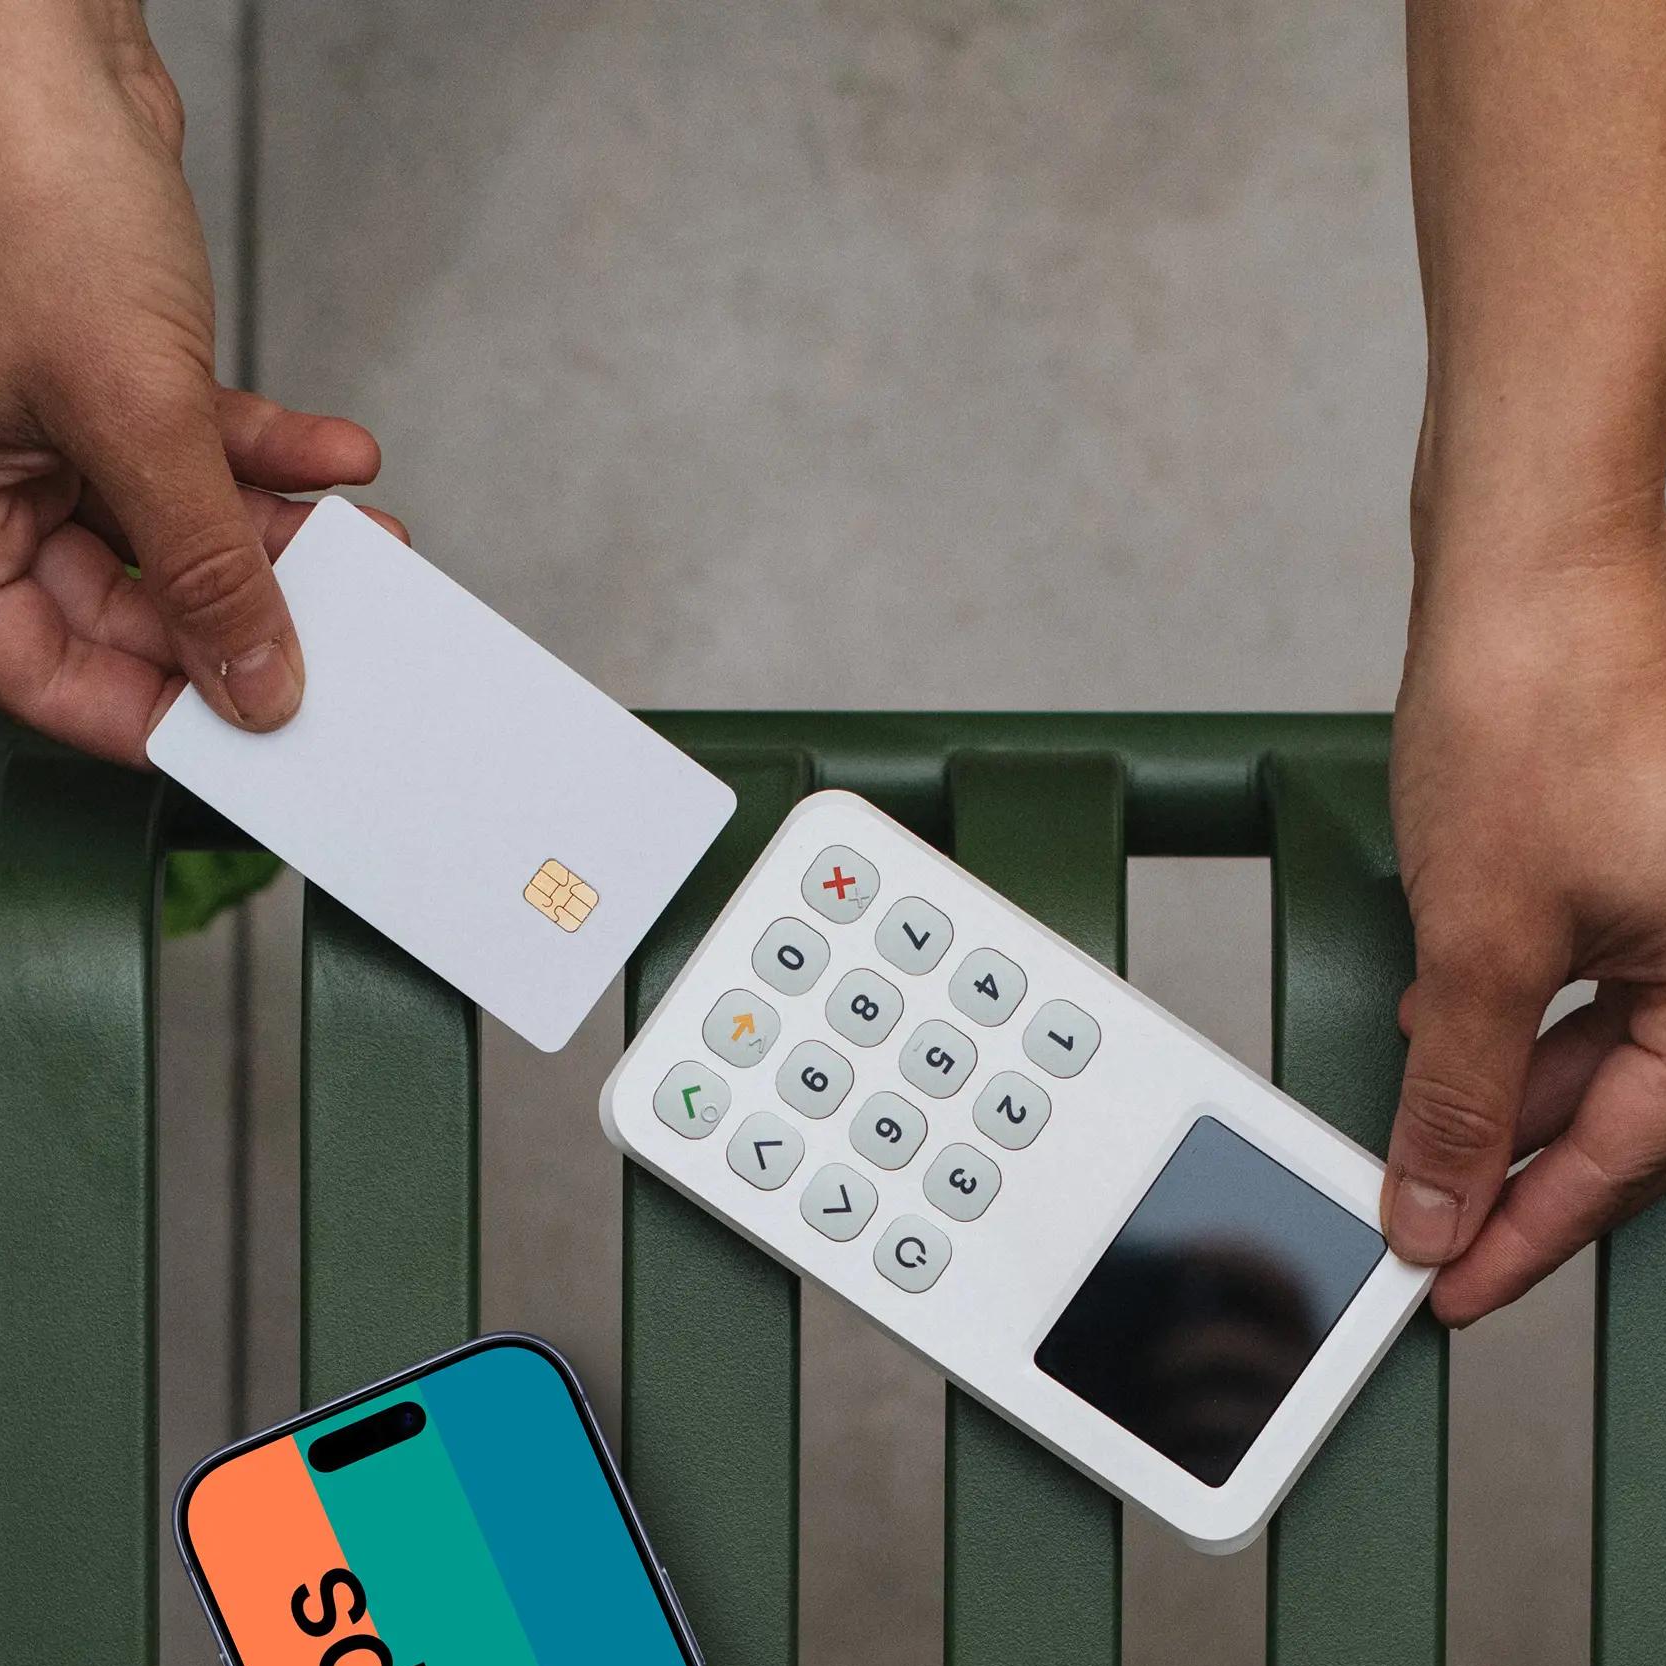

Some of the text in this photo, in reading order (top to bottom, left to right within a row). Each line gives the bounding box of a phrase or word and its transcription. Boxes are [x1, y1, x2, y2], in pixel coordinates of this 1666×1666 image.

[901, 921, 931, 951] 7
[777, 944, 805, 971] 0
[973, 973, 1000, 1001] 4
[850, 994, 880, 1022] 8
[1047, 1030, 1074, 1052] 1
[925, 1046, 956, 1076] 5
[800, 1066, 829, 1093] 9
[996, 1094, 1027, 1125] 2
[875, 1117, 903, 1144] 6
[948, 1167, 978, 1195] 3
